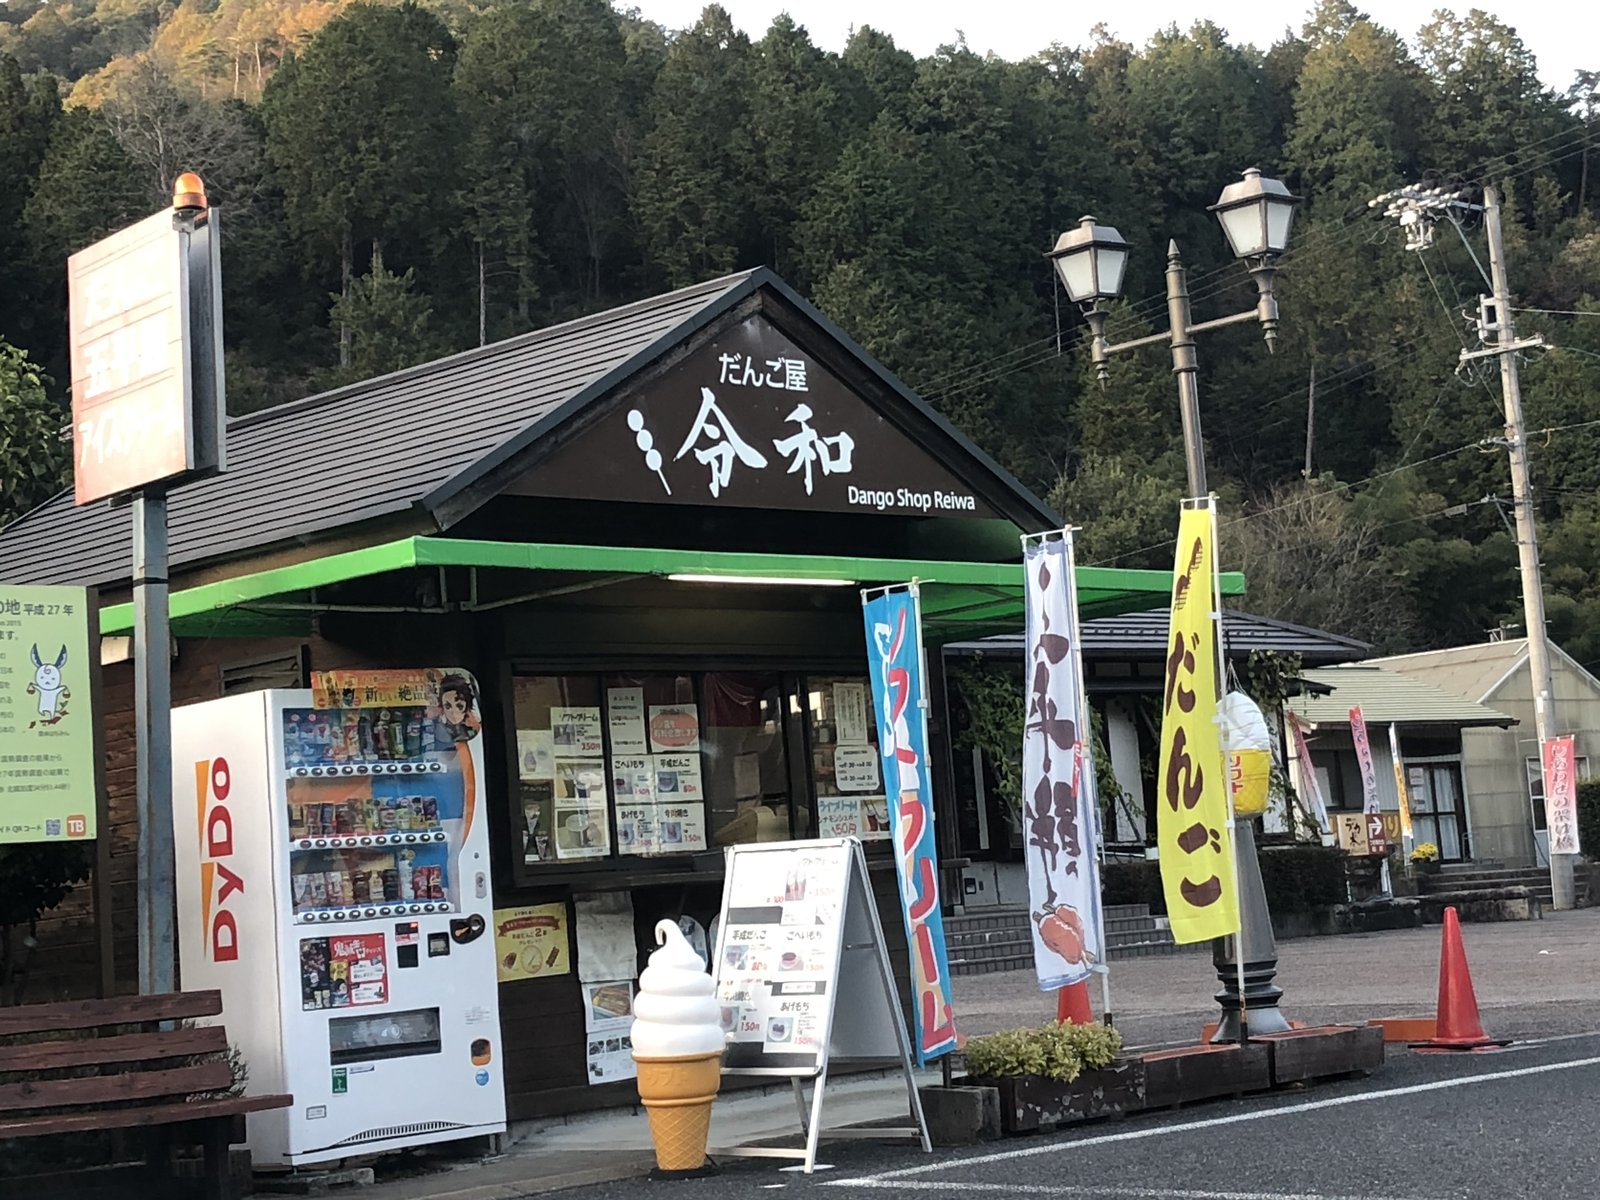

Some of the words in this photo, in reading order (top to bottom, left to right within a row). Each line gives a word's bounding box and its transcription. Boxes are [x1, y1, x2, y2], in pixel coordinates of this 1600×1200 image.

[718, 352, 809, 392] だんご屋
[673, 387, 855, 498] 令和
[847, 485, 895, 511] Dango
[896, 488, 932, 512] Shop
[934, 490, 976, 511] Reiwa
[1164, 630, 1222, 908] だんご
[67, 819, 85, 833] TB
